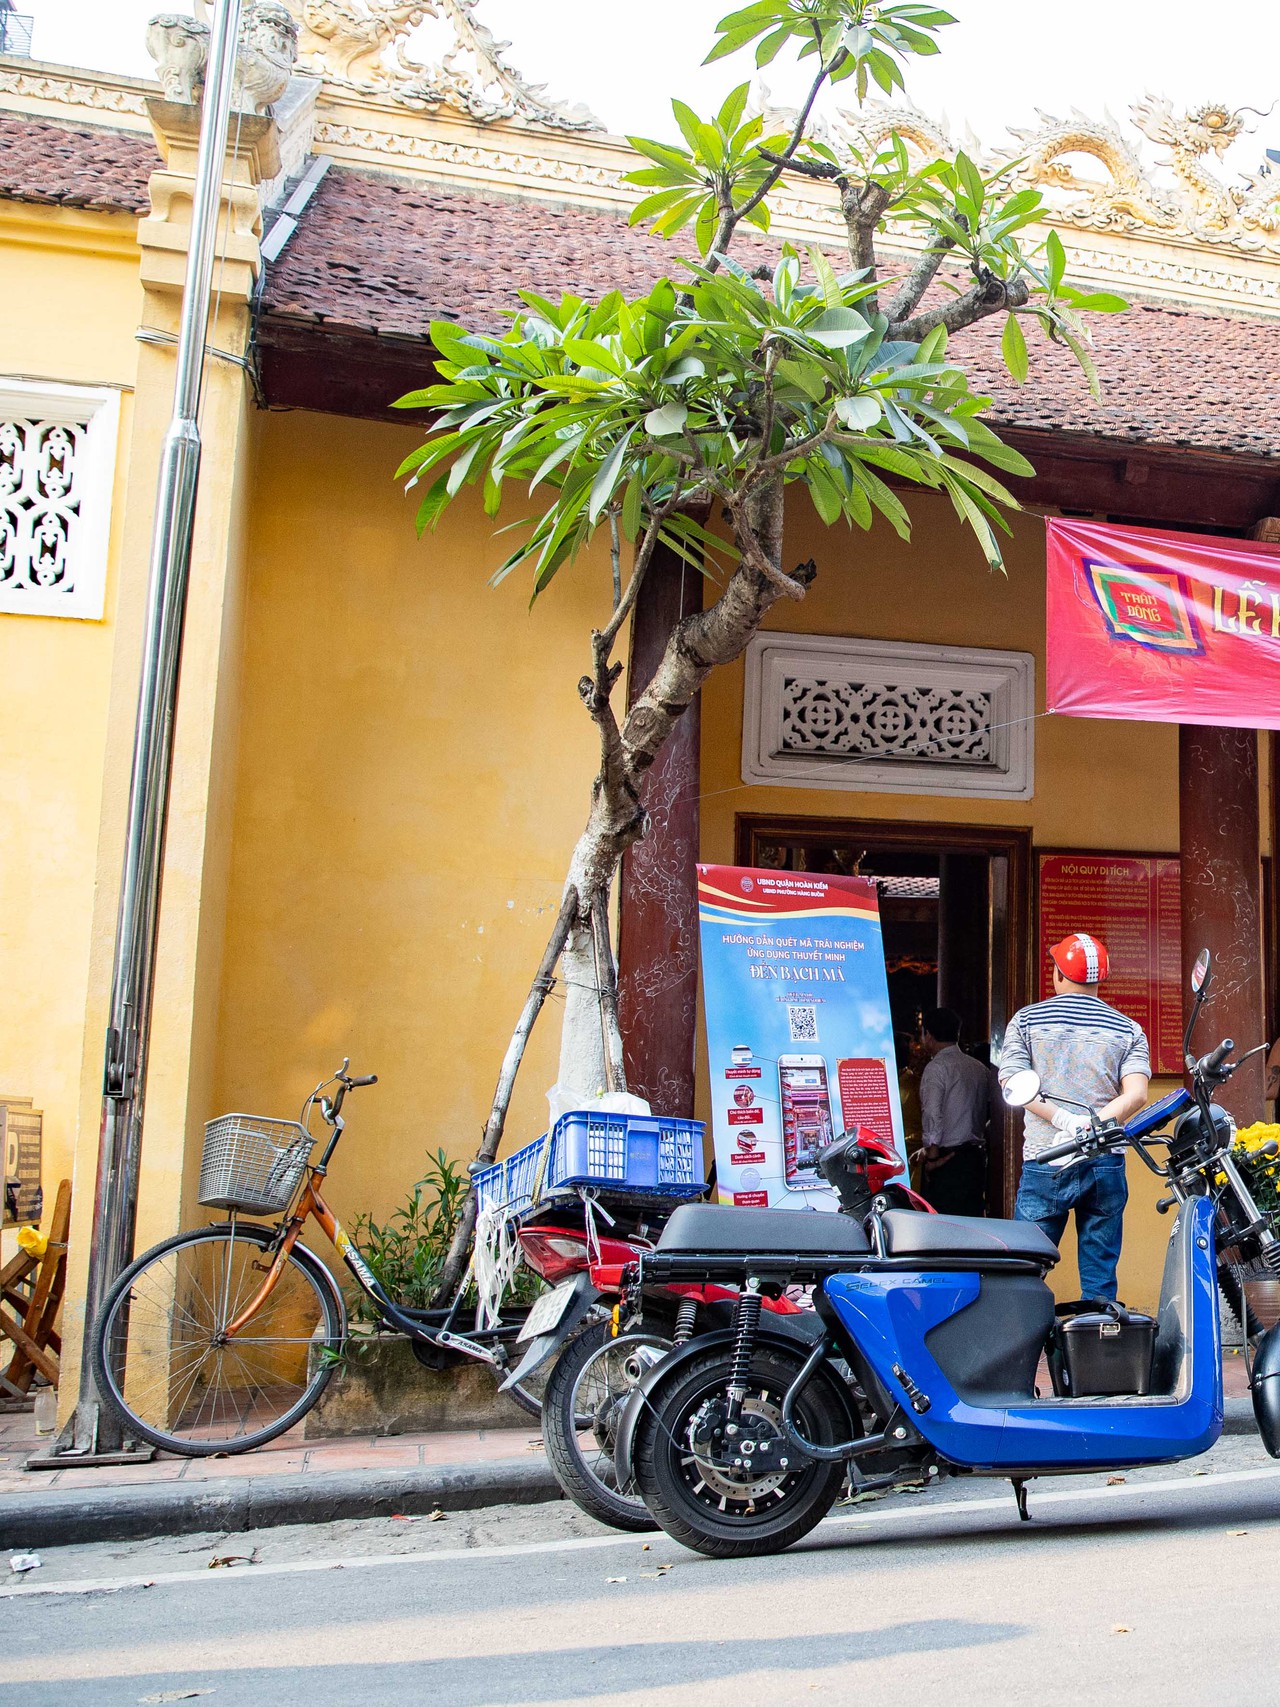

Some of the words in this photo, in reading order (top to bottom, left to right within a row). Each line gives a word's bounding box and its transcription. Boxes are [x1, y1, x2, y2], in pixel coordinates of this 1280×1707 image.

[1212, 580, 1266, 636] LỄ
[1061, 864, 1078, 876] NỘI
[1080, 866, 1099, 875] QUY
[1100, 866, 1108, 875] DI
[1110, 865, 1129, 876] TÍCH
[722, 932, 754, 945] HƯỚNG
[776, 935, 797, 947] QUÉT
[800, 937, 812, 948] MÃ
[834, 939, 865, 952] NGHIỆM
[747, 946, 764, 957] ỨNG
[766, 950, 790, 959] DỤNG
[792, 949, 822, 960] THUYẾT
[824, 953, 846, 962] MINH
[750, 960, 778, 980] ĐỀN
[781, 965, 819, 984] BẠCH
[822, 965, 846, 982] MÃ
[340, 1243, 377, 1287] ASAMA
